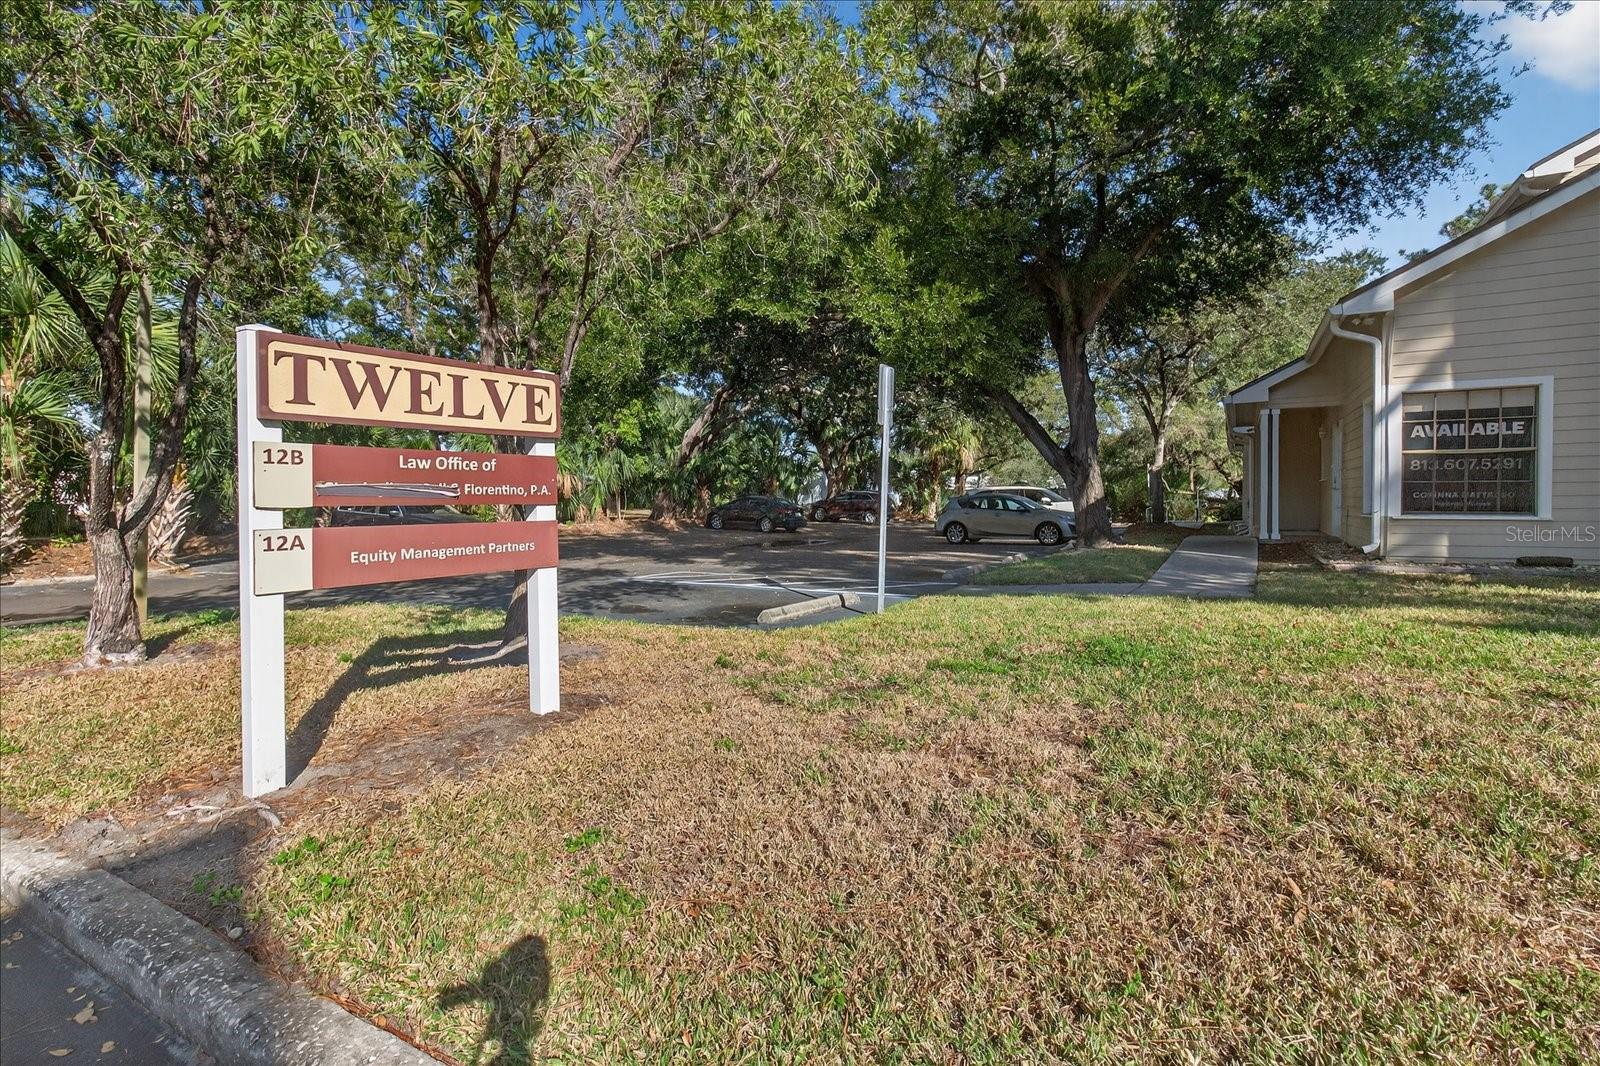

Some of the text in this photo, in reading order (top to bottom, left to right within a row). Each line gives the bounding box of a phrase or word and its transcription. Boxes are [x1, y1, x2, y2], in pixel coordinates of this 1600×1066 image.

[273, 350, 553, 426] TWELVE
[1410, 421, 1525, 438] AVAILABLE
[262, 448, 304, 466] 12B
[399, 454, 497, 472] Law Office of
[464, 483, 528, 497] Florentino,
[530, 485, 552, 496] P.A.
[262, 534, 305, 552] 12A
[350, 540, 535, 566] Equity Management Partners
